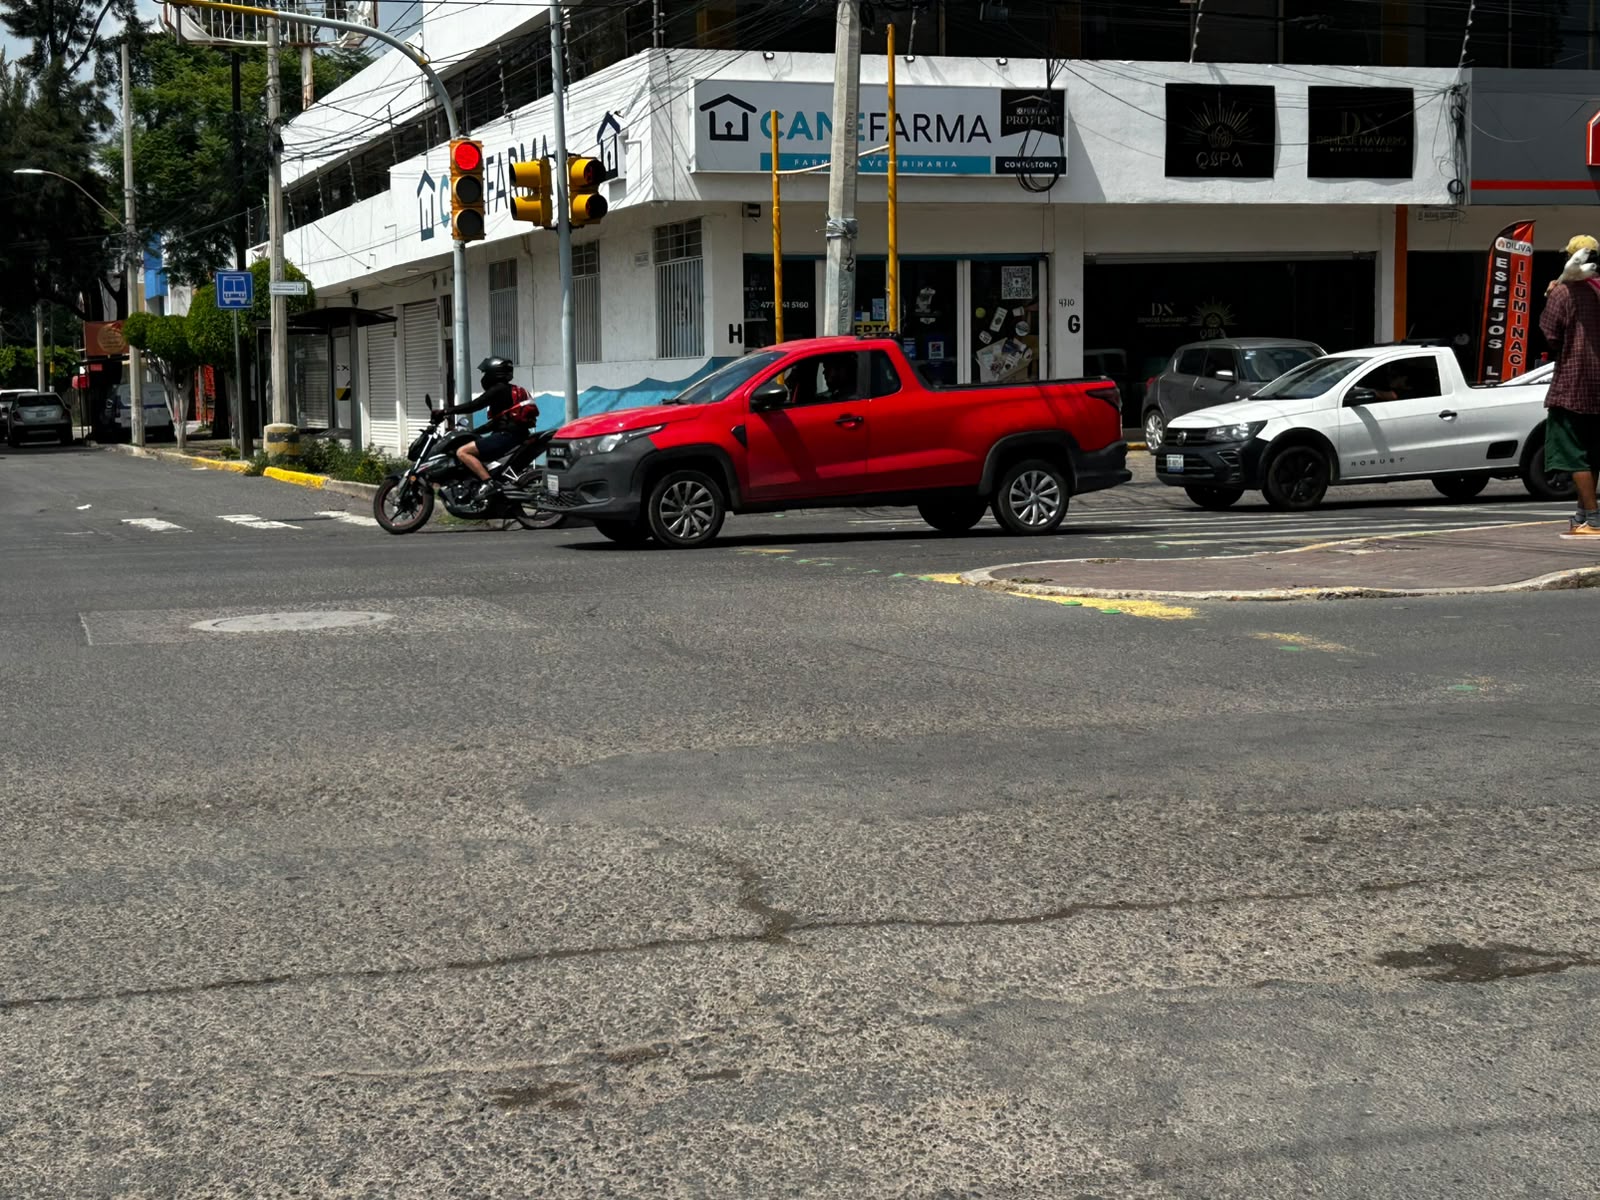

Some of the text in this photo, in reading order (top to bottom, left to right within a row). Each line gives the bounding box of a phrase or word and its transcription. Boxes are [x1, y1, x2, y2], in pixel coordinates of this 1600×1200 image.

[760, 110, 991, 143] CANEFARMA
[868, 159, 957, 168] VERINARIA
[1505, 240, 1532, 253] DILIVA
[1488, 257, 1508, 349] ESPEJOS
[728, 323, 743, 344] H
[1067, 314, 1081, 334] G
[1351, 456, 1405, 467] ROBUST
